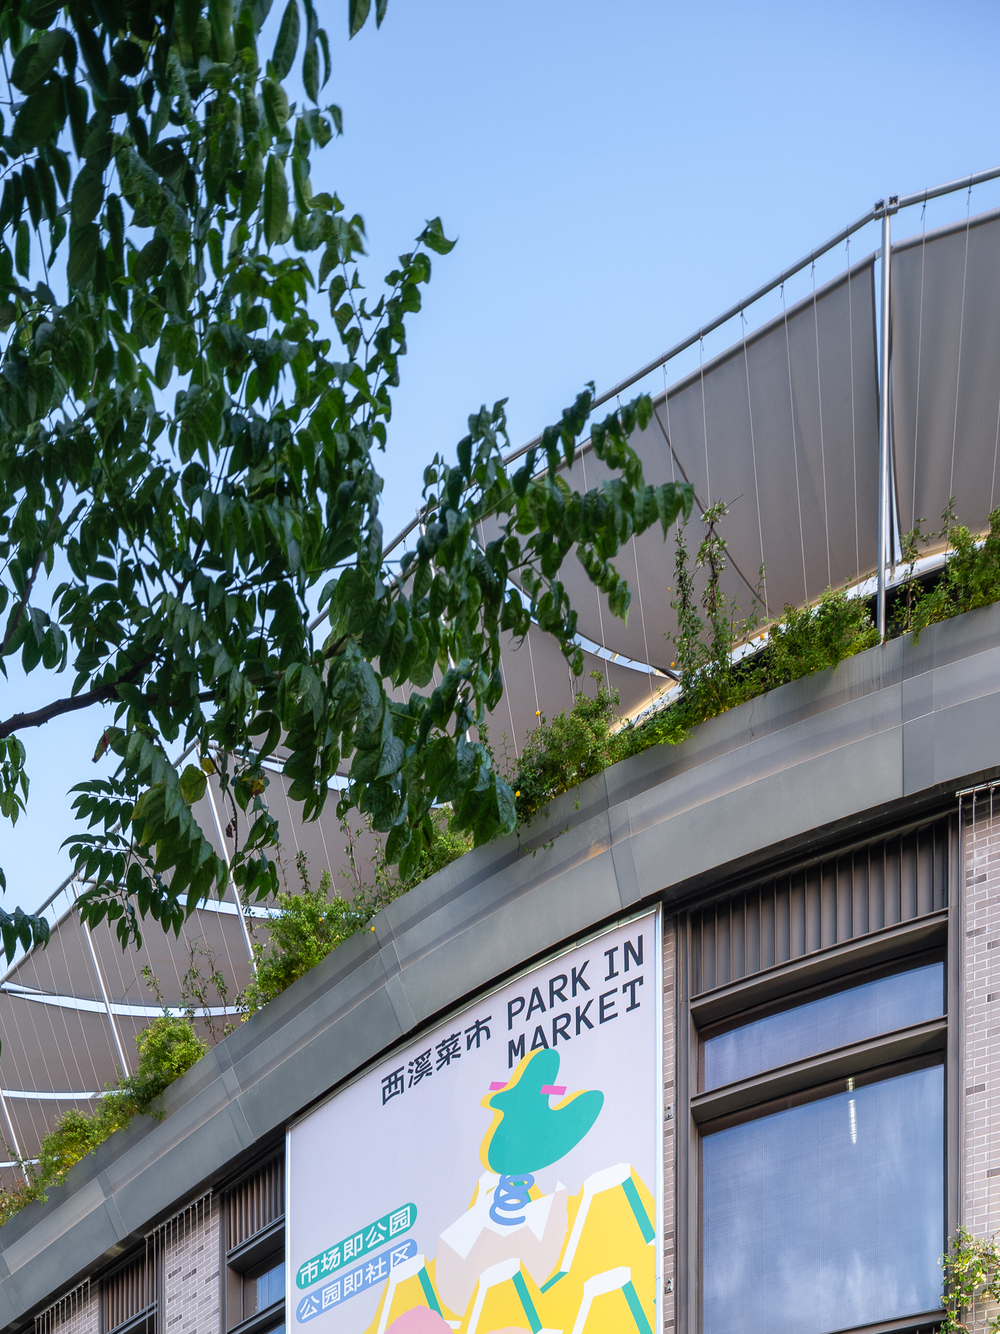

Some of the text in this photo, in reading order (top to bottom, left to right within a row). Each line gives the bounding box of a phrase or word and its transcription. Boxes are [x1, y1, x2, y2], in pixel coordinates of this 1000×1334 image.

[381, 934, 644, 1106] 西溪菜市 PARK IN
[508, 975, 644, 1069] MARKET
[300, 1205, 410, 1285] 市场即公园
[300, 1242, 411, 1320] 公园即社区
